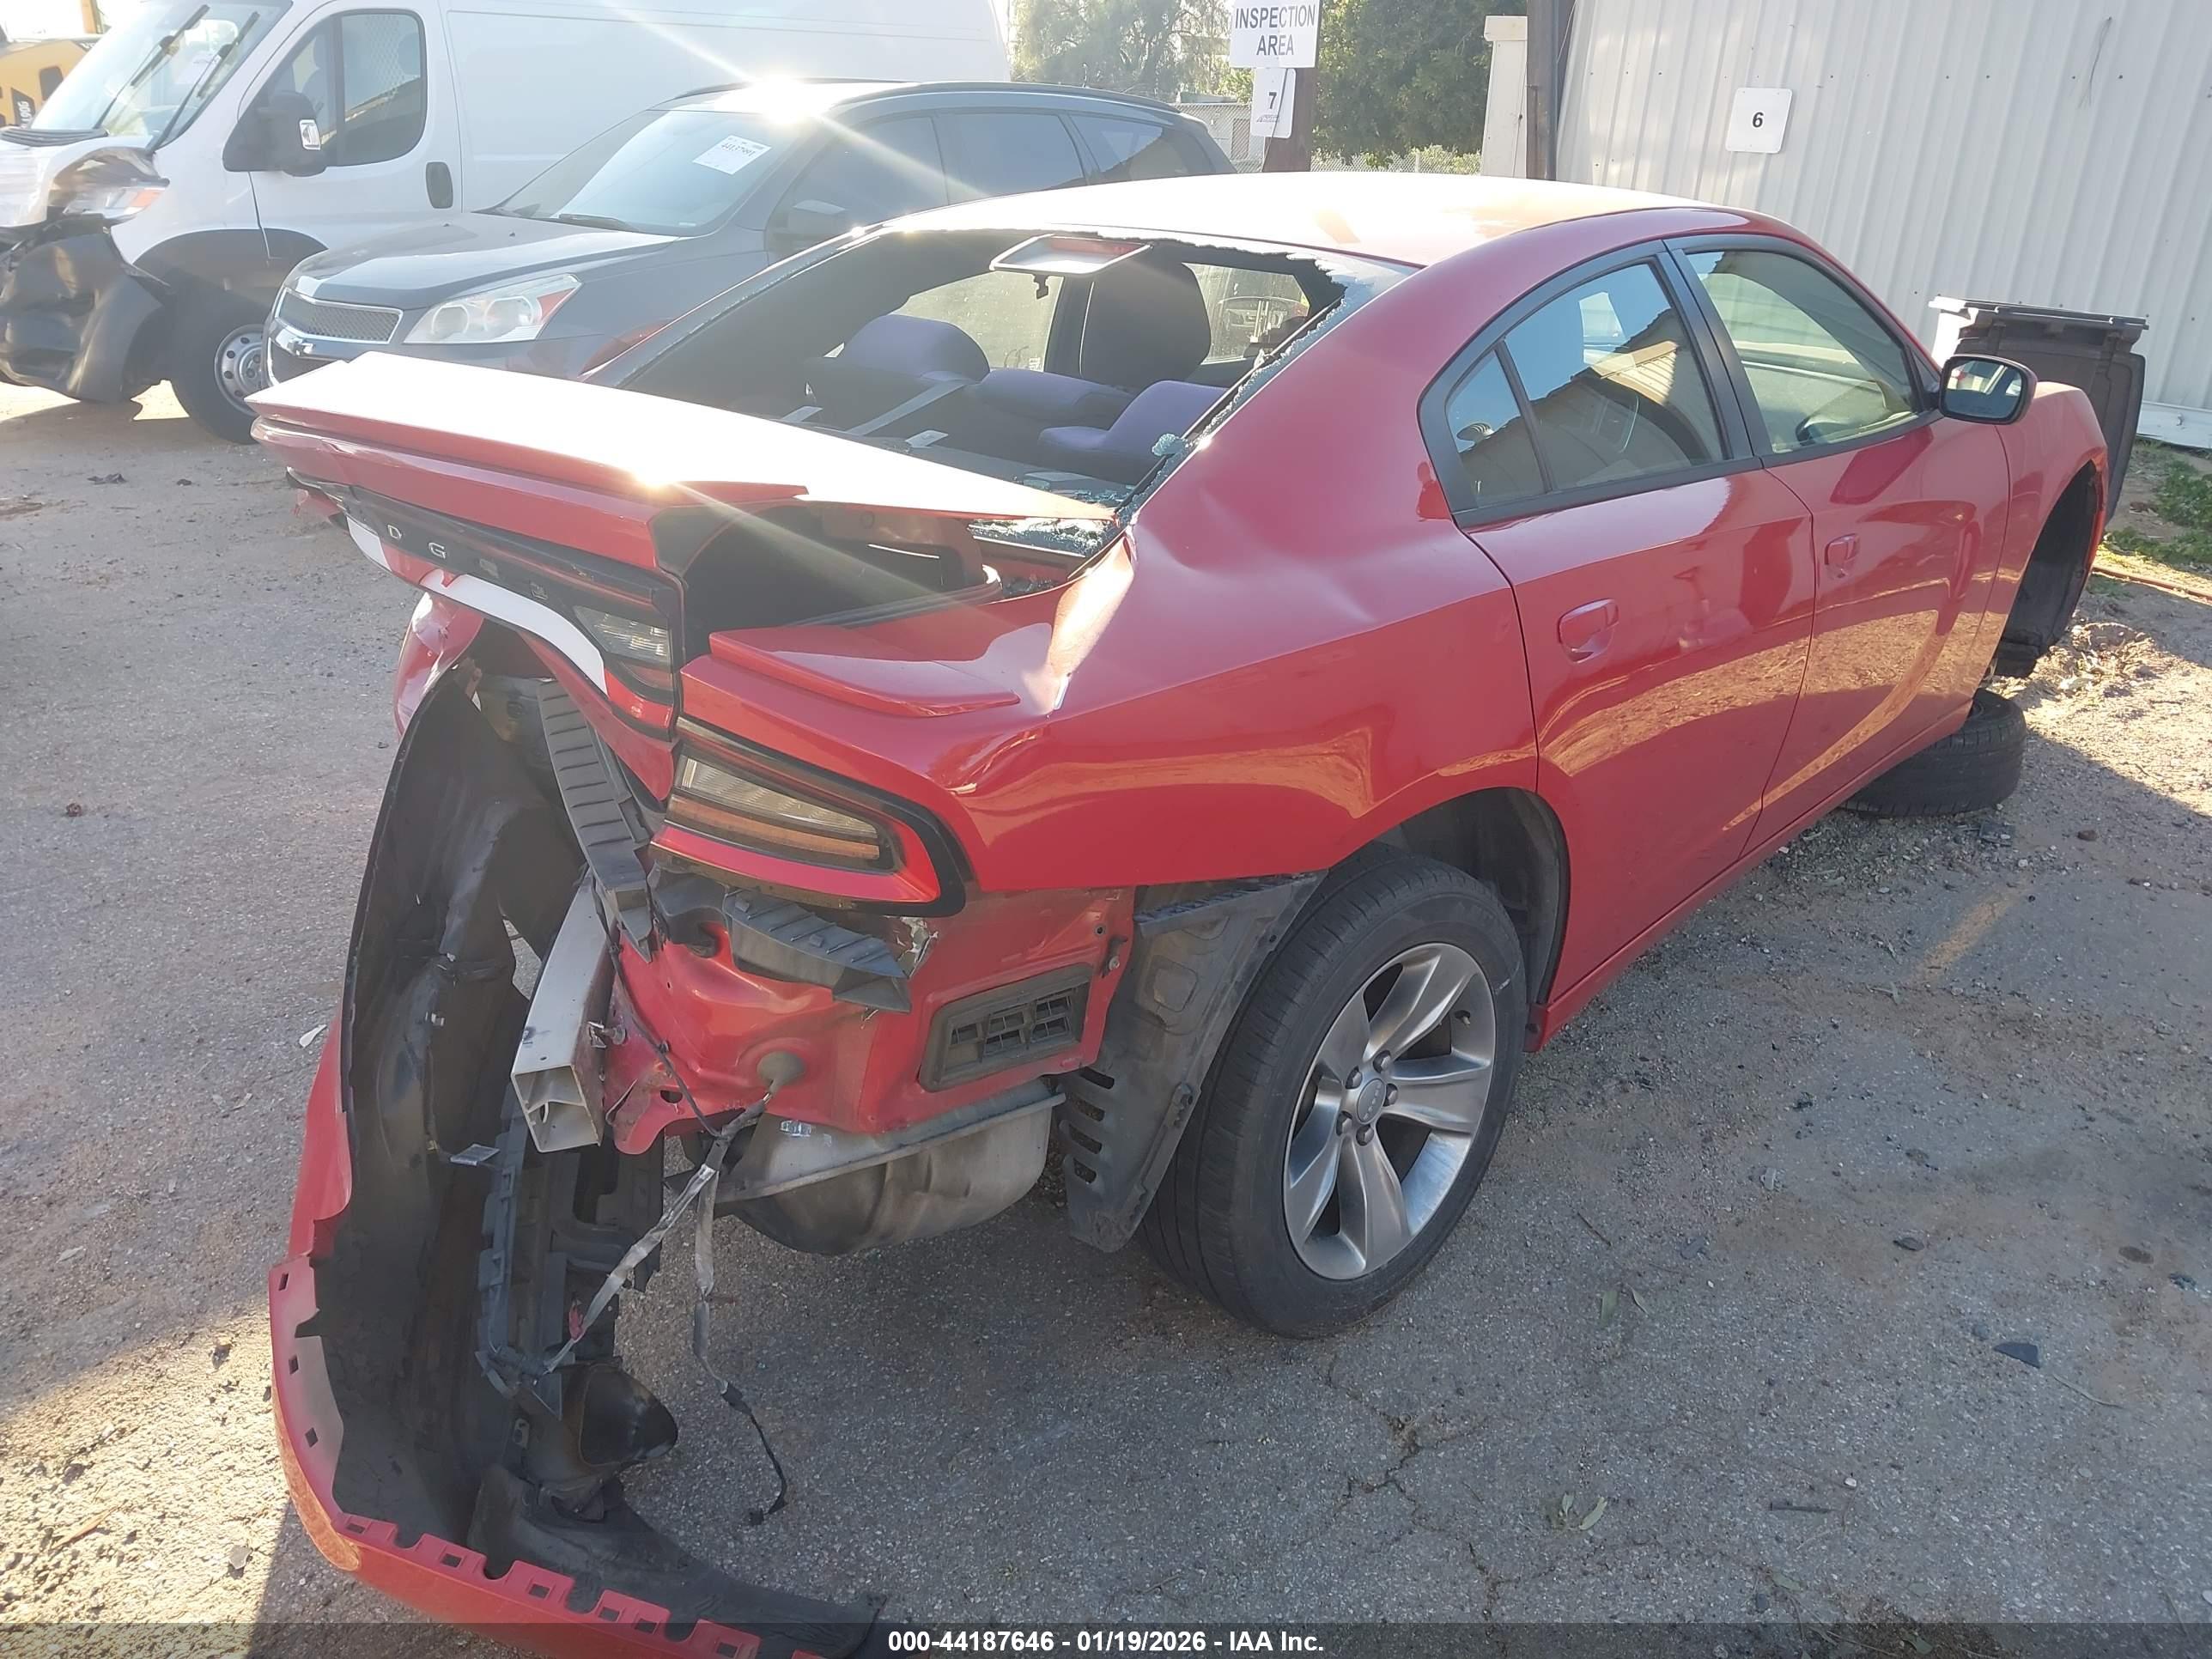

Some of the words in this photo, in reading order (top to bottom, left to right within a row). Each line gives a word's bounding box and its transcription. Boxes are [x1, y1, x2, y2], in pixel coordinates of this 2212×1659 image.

[1235, 4, 1316, 29] INSPECTION
[1256, 34, 1294, 56] AREA
[1268, 92, 1277, 110] 7
[1752, 112, 1765, 128] 6
